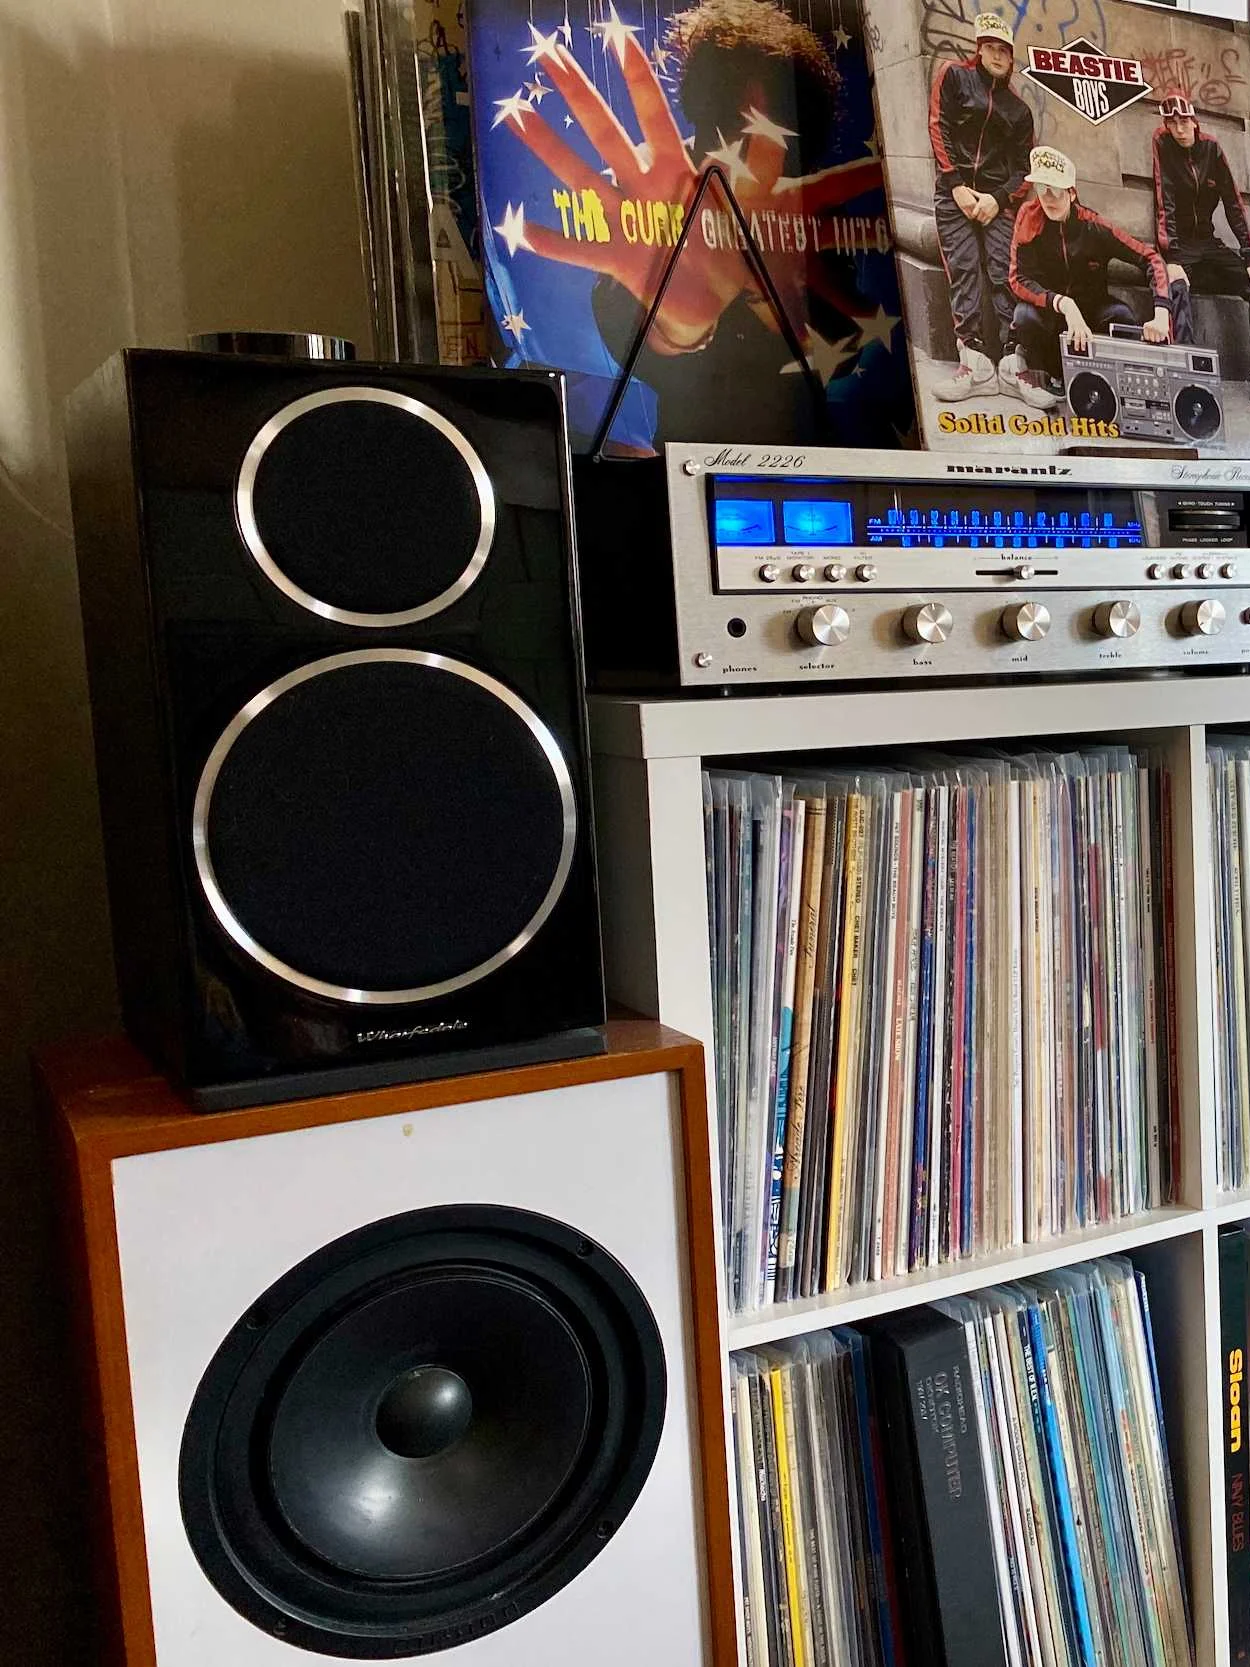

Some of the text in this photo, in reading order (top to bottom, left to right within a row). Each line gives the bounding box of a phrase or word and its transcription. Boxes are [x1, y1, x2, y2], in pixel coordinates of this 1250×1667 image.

[1033, 48, 1139, 82] BEASTIE
[1072, 77, 1110, 119] BOYS
[553, 188, 687, 248] THE CURE
[938, 411, 1120, 438] Solid Gold Hits
[704, 448, 806, 468] Model 2226
[946, 464, 1072, 476] marantz
[912, 658, 933, 666] bass
[1011, 655, 1028, 663] mid
[1099, 652, 1122, 660] treble
[722, 665, 758, 674] phones
[799, 662, 836, 670] selector
[1023, 1344, 1032, 1357] THE
[1025, 1357, 1034, 1374] BEST
[1028, 1374, 1036, 1384] OF
[953, 1365, 968, 1434] RADIOHEAD
[1229, 1348, 1243, 1453] Sloan
[934, 1371, 963, 1501] OK COMPUTER
